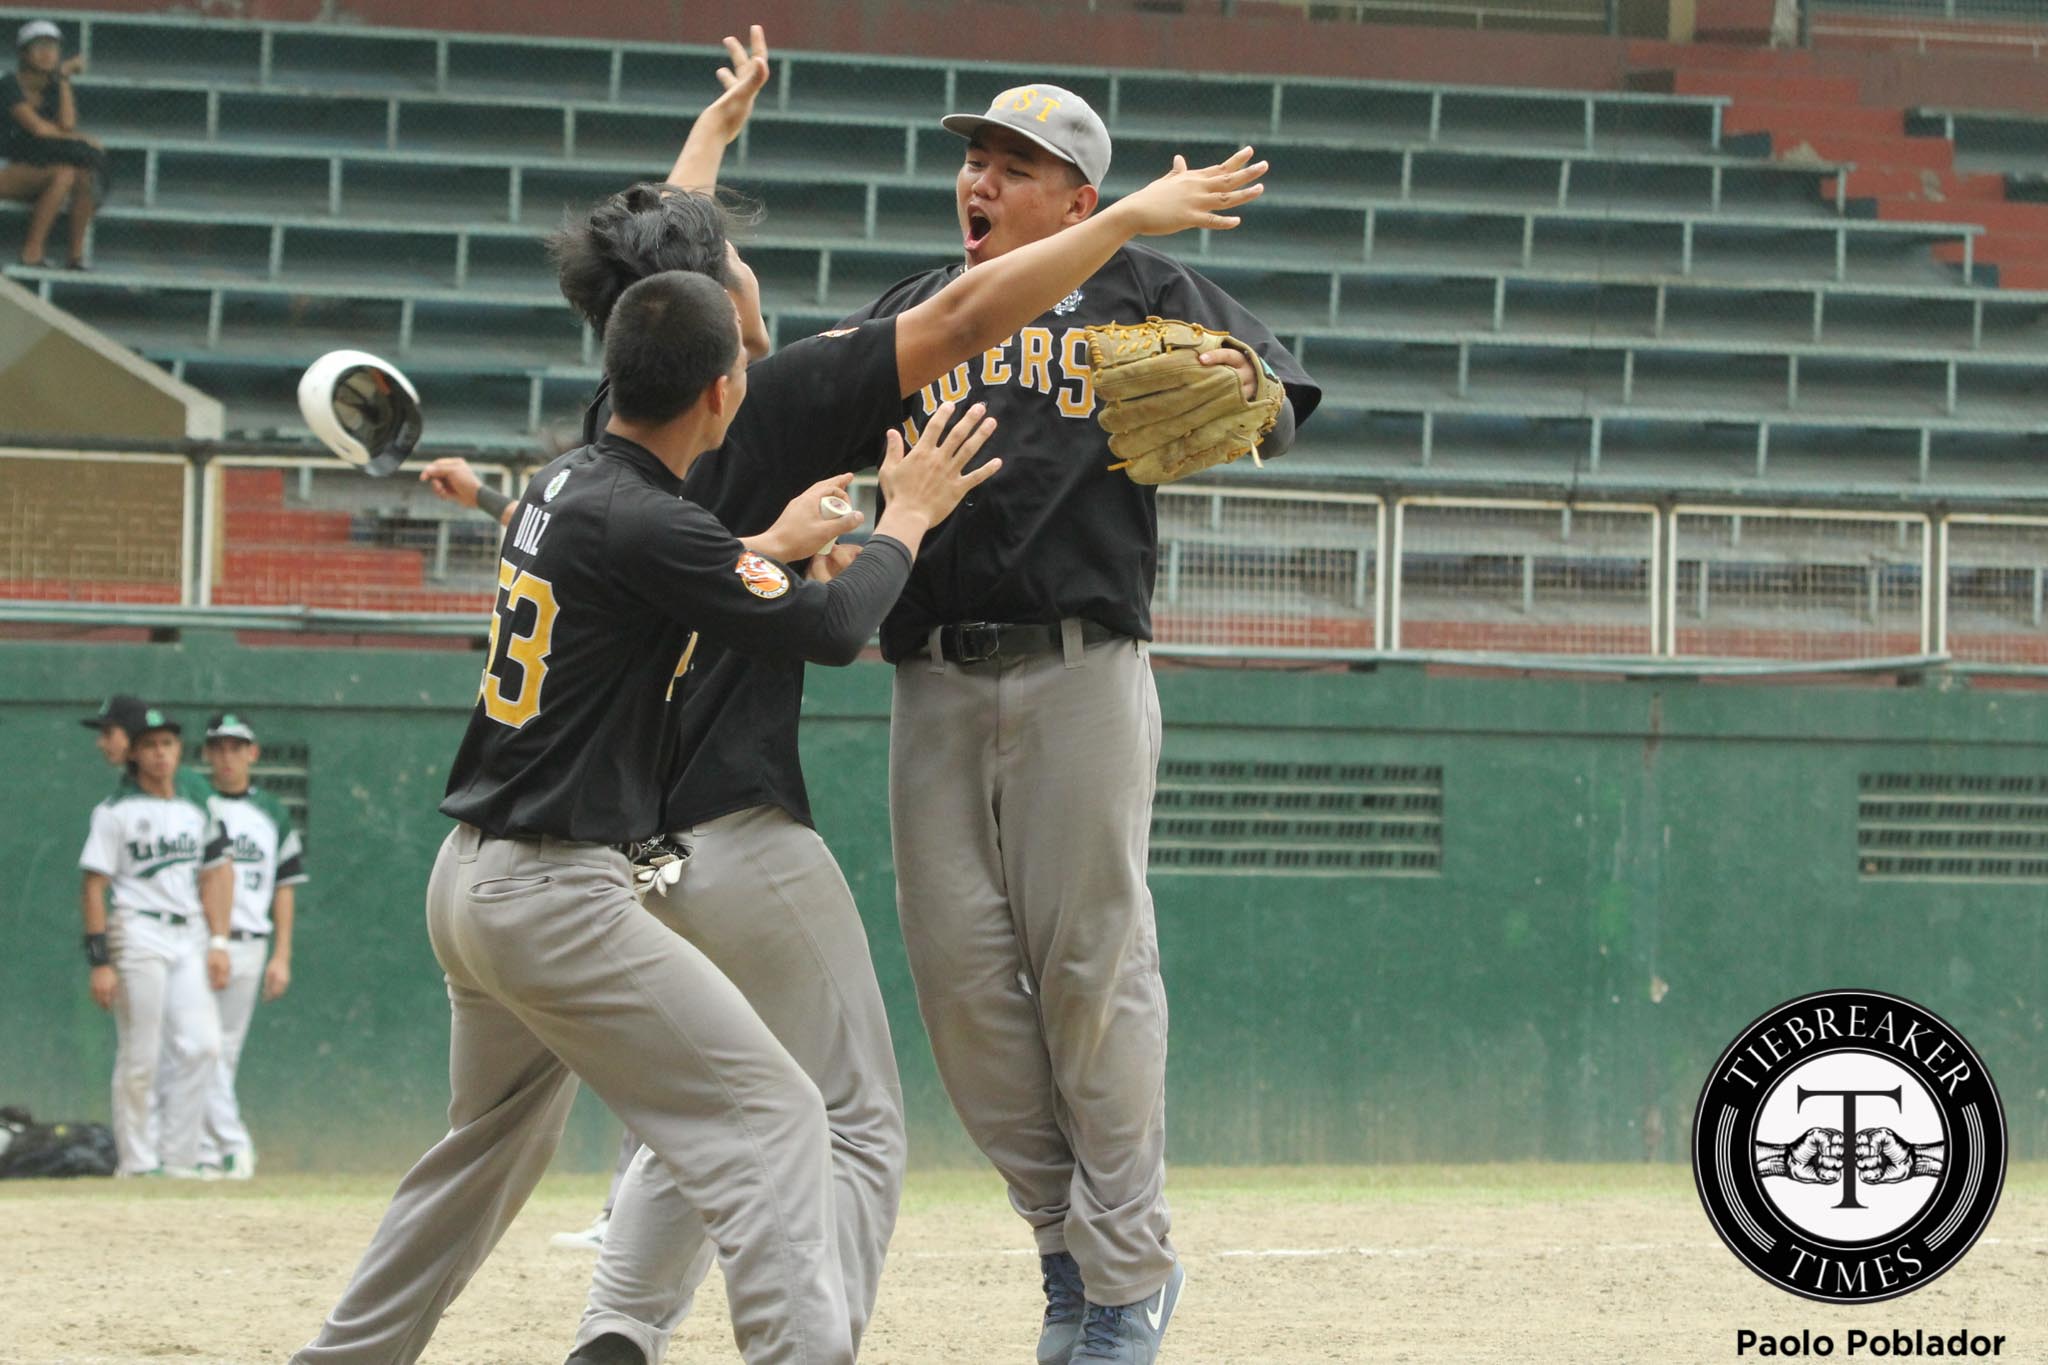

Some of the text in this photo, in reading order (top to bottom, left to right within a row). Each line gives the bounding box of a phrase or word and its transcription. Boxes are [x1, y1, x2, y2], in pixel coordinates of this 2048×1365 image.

[902, 326, 1096, 447] GERS
[512, 503, 551, 556] DIAZ
[476, 557, 560, 729] 53
